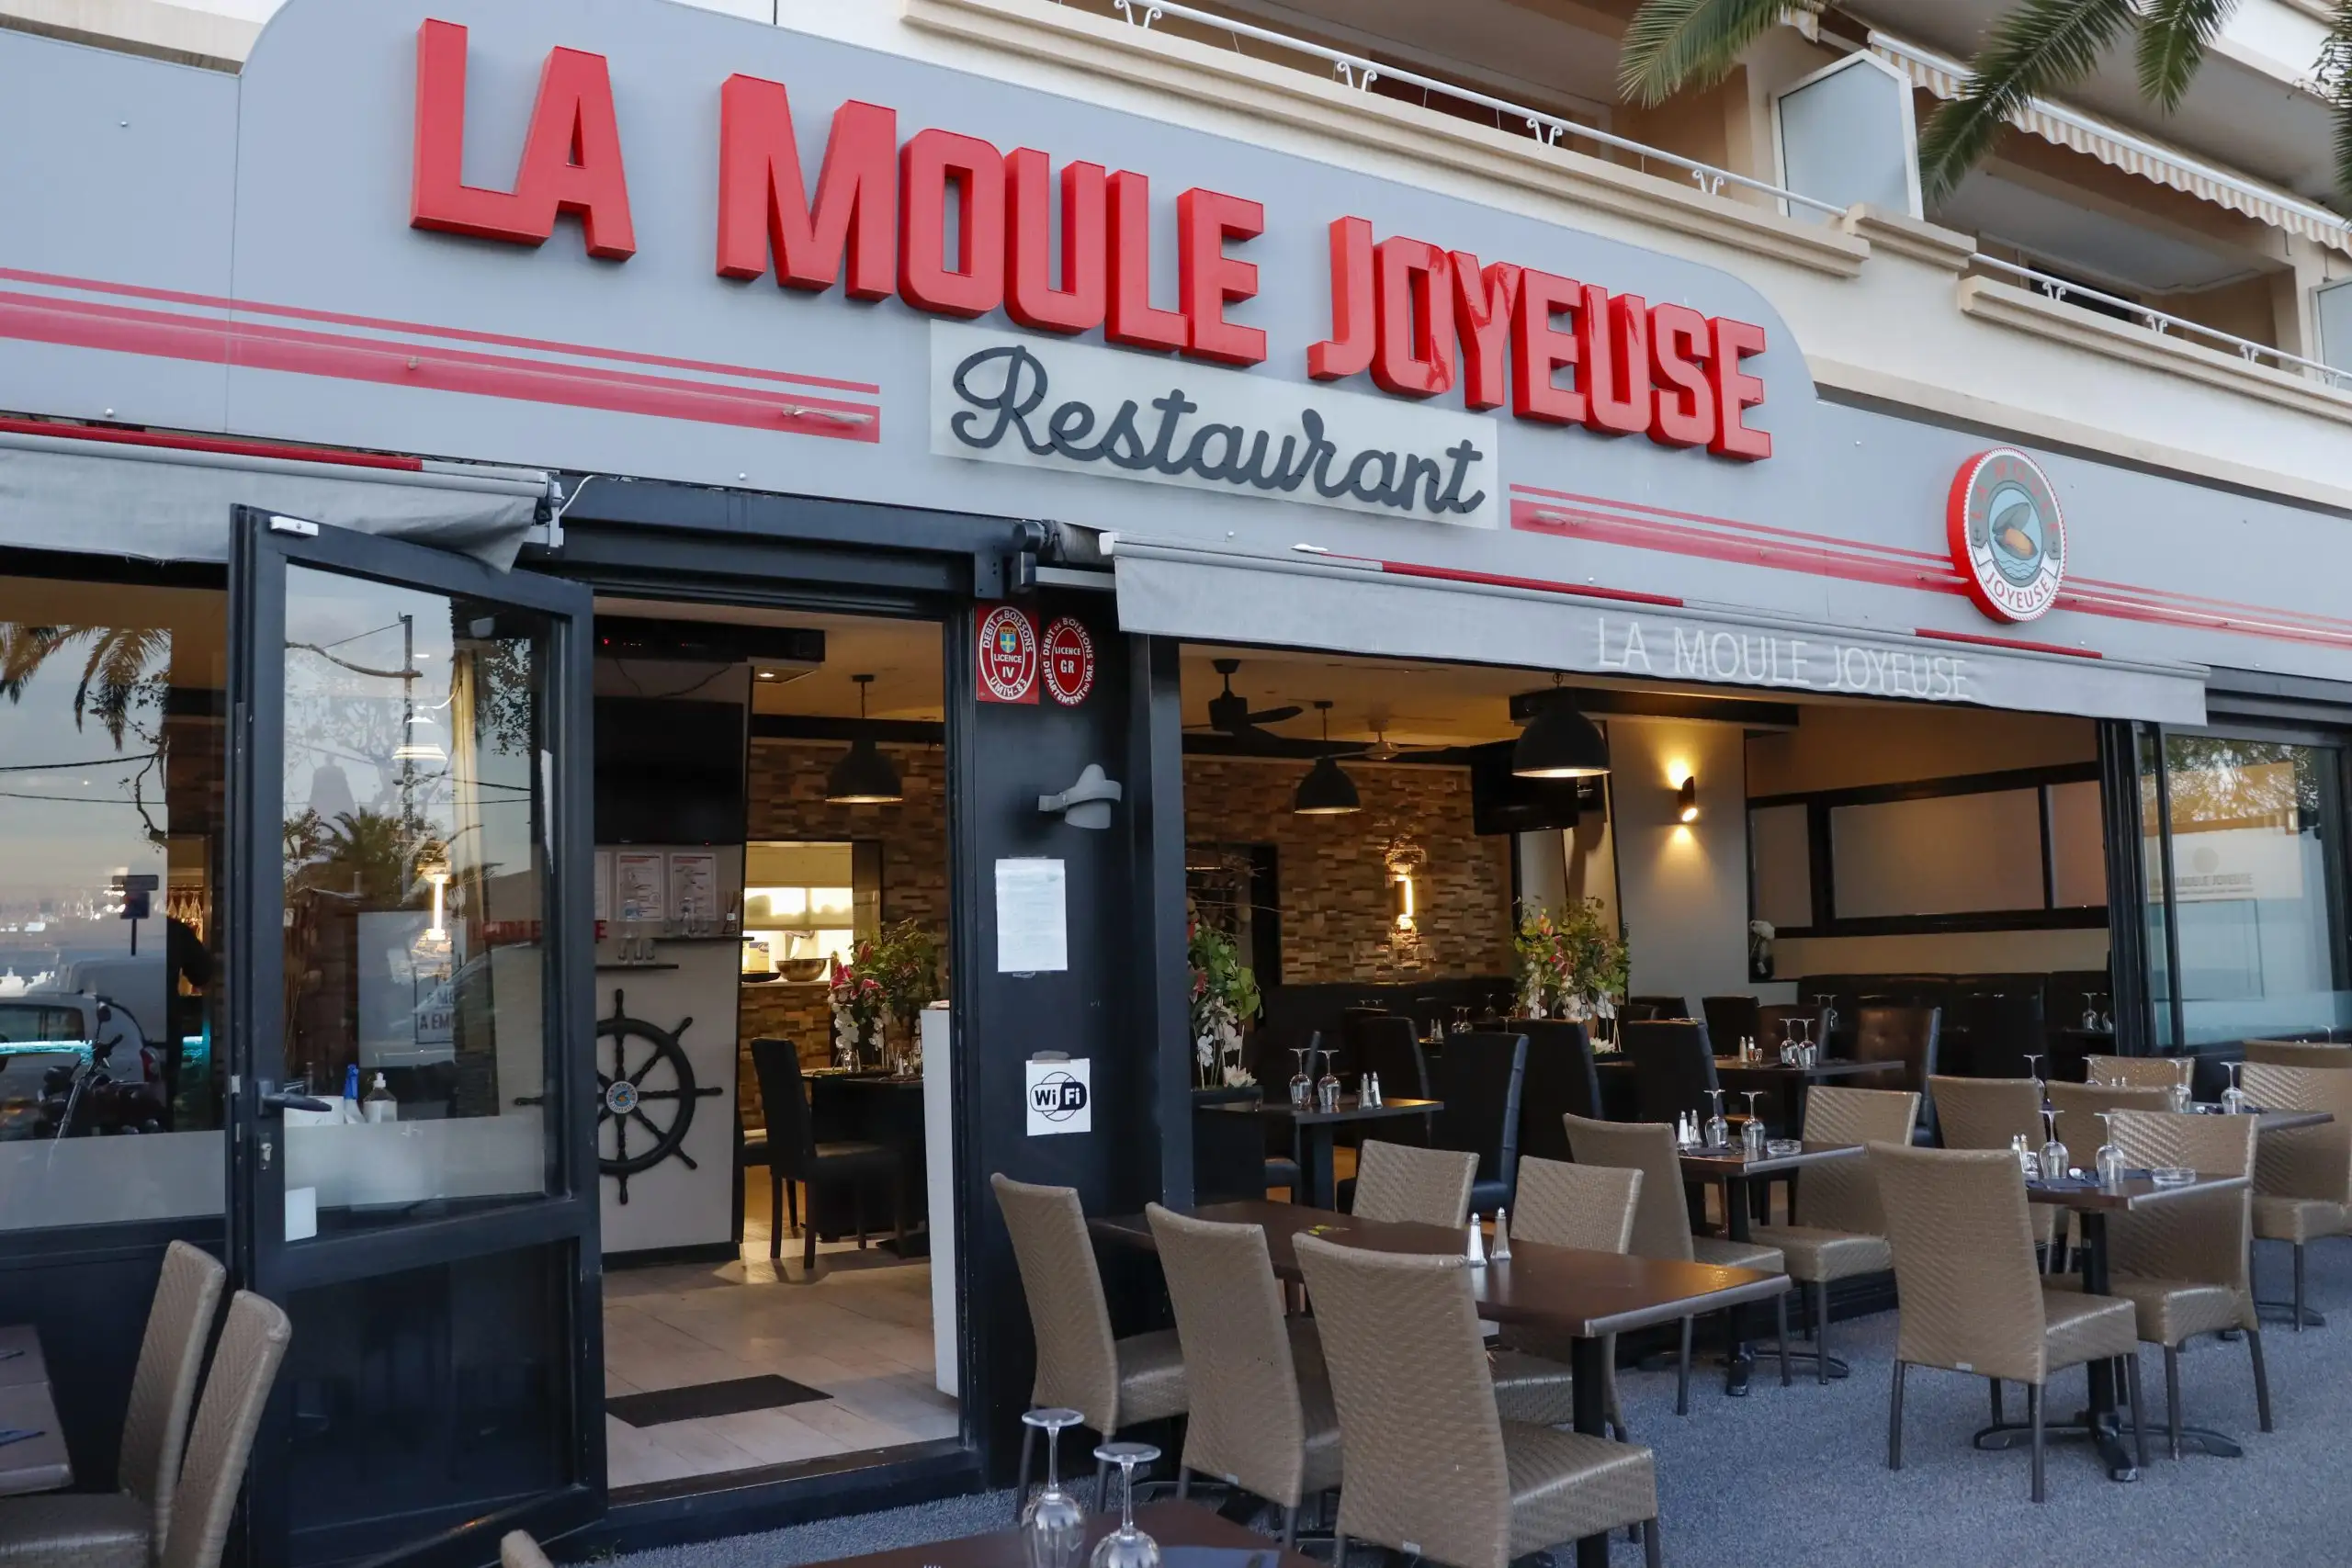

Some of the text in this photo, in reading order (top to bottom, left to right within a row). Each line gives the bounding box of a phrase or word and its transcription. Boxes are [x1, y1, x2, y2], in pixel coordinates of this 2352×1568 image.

[410, 17, 1772, 462] LA MOULE JOYEUSE
[950, 344, 1486, 515] Restaurant
[1984, 570, 2051, 609] JOYEUSE
[982, 617, 998, 649] DEBIT
[1003, 610, 1034, 653] BOISSONS
[1042, 627, 1056, 656] DEBIT
[1061, 617, 1094, 660] BOISSONS
[1055, 647, 1081, 656] LICENCE
[993, 653, 1023, 664] LICENCE
[1001, 666, 1015, 678] IV
[1059, 660, 1075, 674] GR
[1597, 617, 1973, 701] LA MOULE JOYEUSE
[989, 676, 1028, 697] UMIH-83
[1042, 660, 1086, 705] DEPARTEMENT
[1085, 664, 1094, 682] VAR
